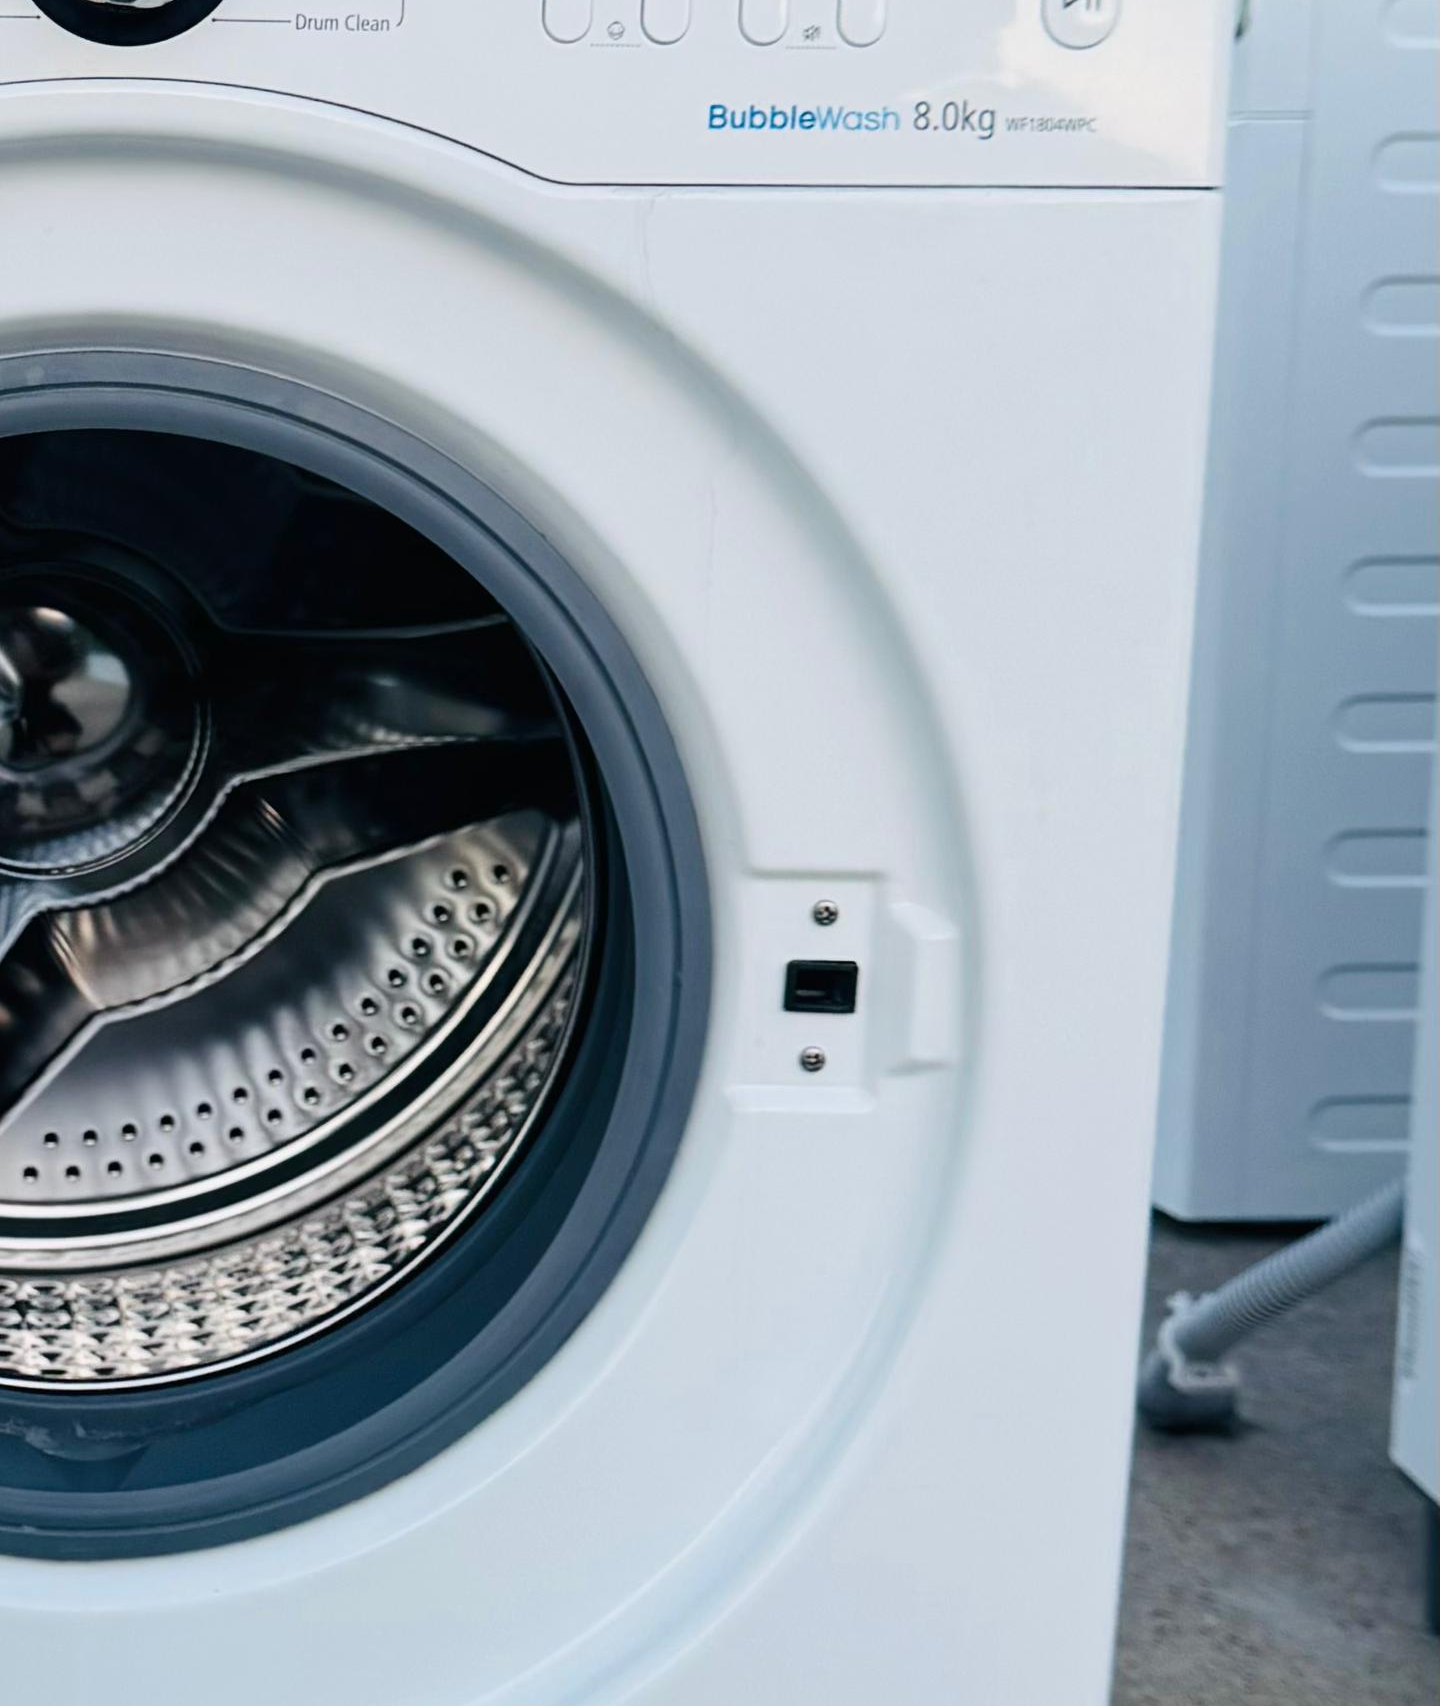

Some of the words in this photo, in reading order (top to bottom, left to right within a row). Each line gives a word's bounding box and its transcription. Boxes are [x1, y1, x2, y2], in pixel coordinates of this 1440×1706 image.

[296, 14, 338, 30] Drum
[345, 15, 389, 31] Clean
[709, 105, 898, 130] BubbleWash
[914, 101, 995, 140] 8.0kg
